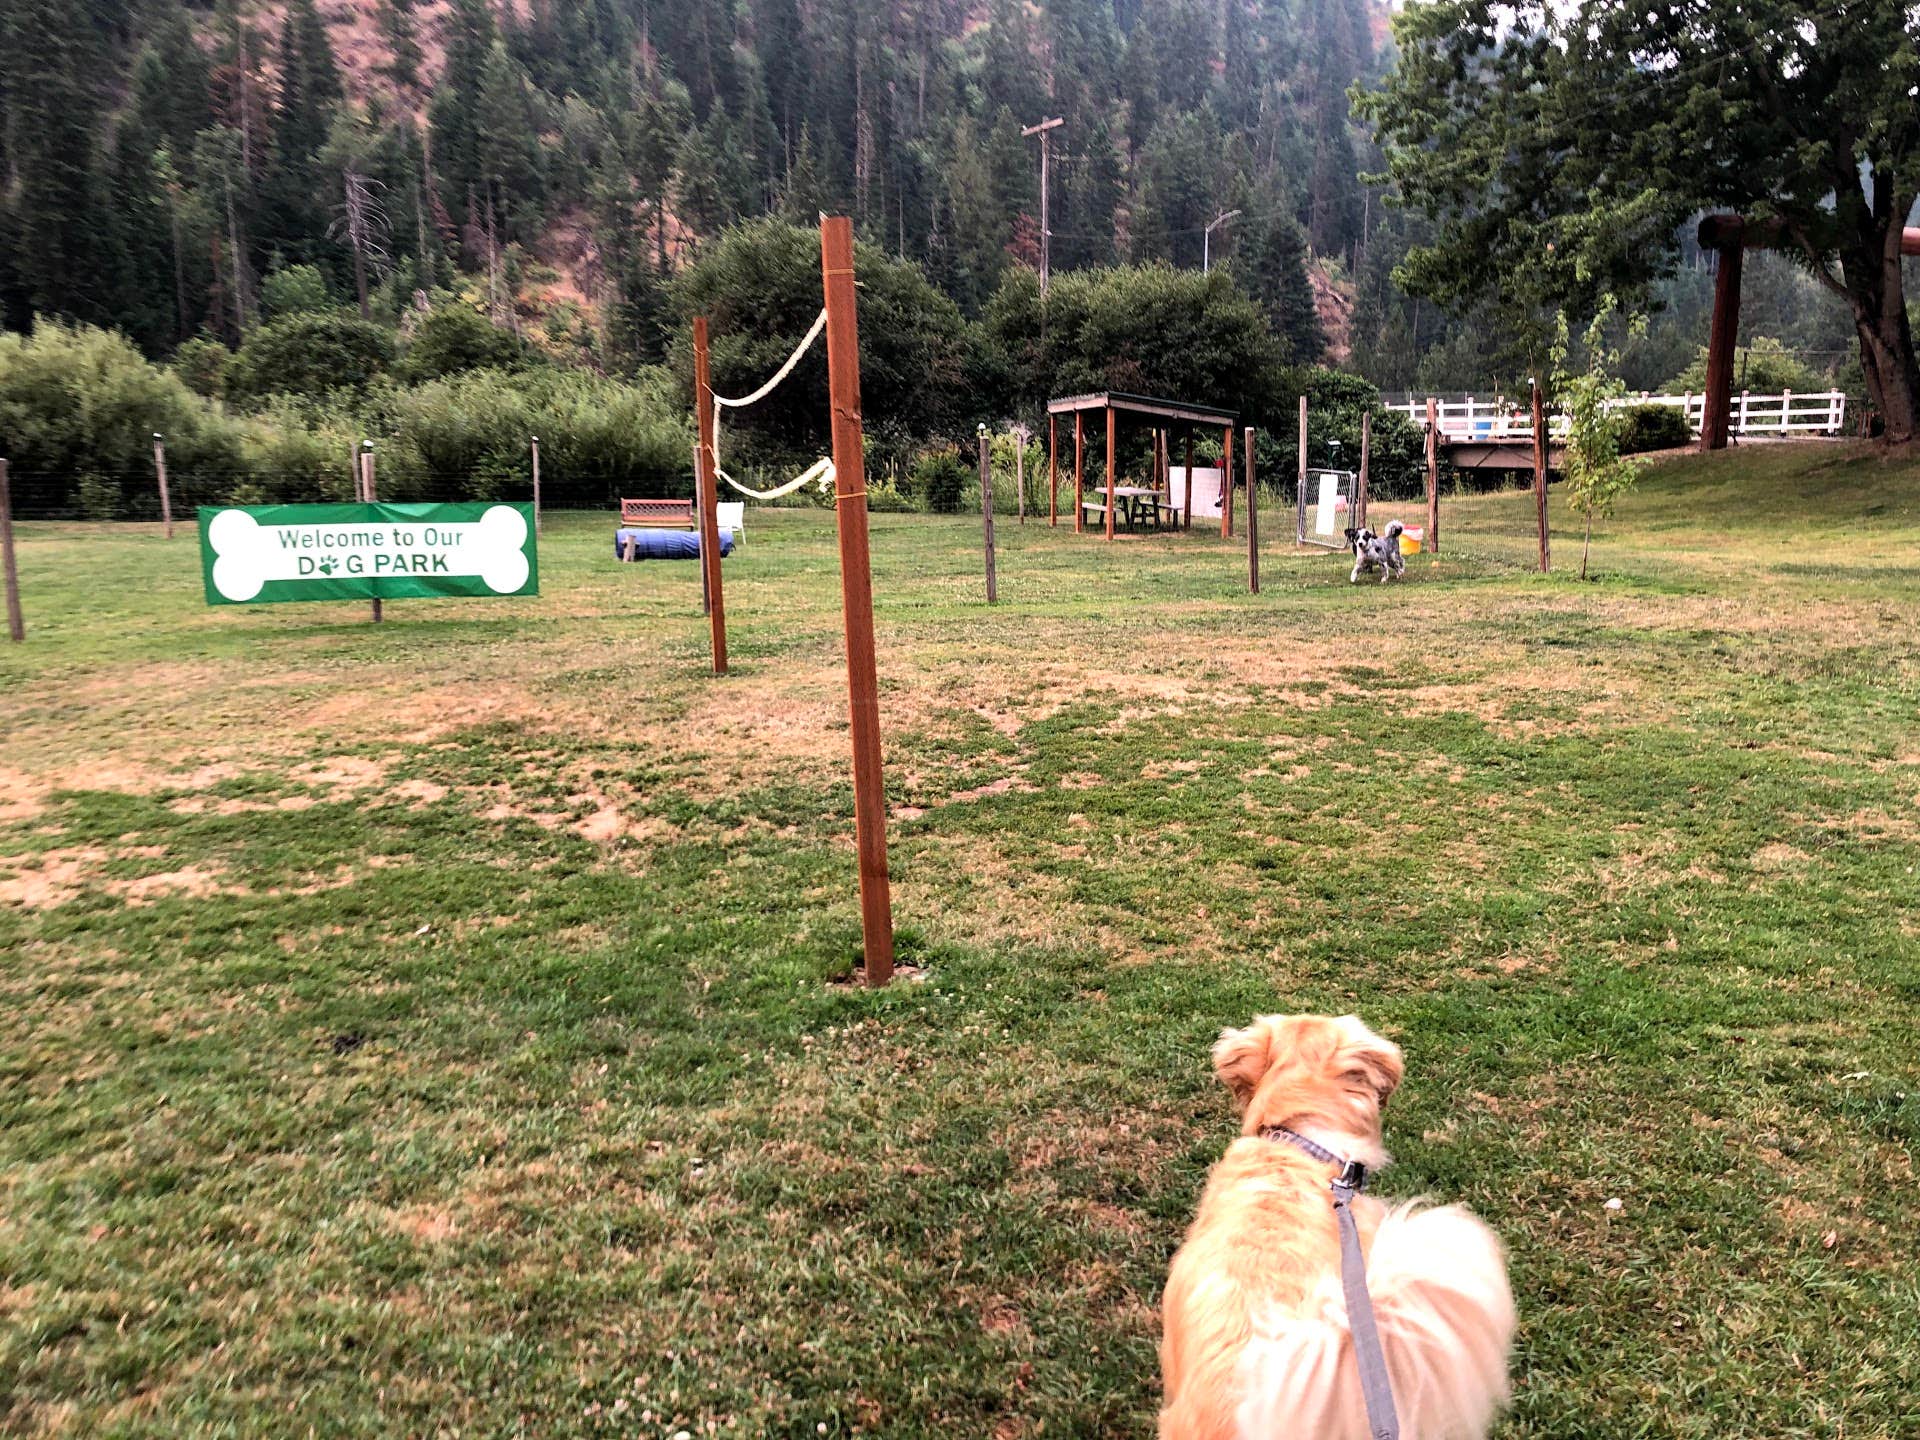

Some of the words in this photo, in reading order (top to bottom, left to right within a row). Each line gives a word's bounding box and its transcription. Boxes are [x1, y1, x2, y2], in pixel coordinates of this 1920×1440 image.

[278, 528, 385, 549] Welcome
[393, 528, 415, 546] to
[424, 528, 464, 546] Our
[298, 554, 364, 576] DG
[374, 553, 449, 573] PARK
